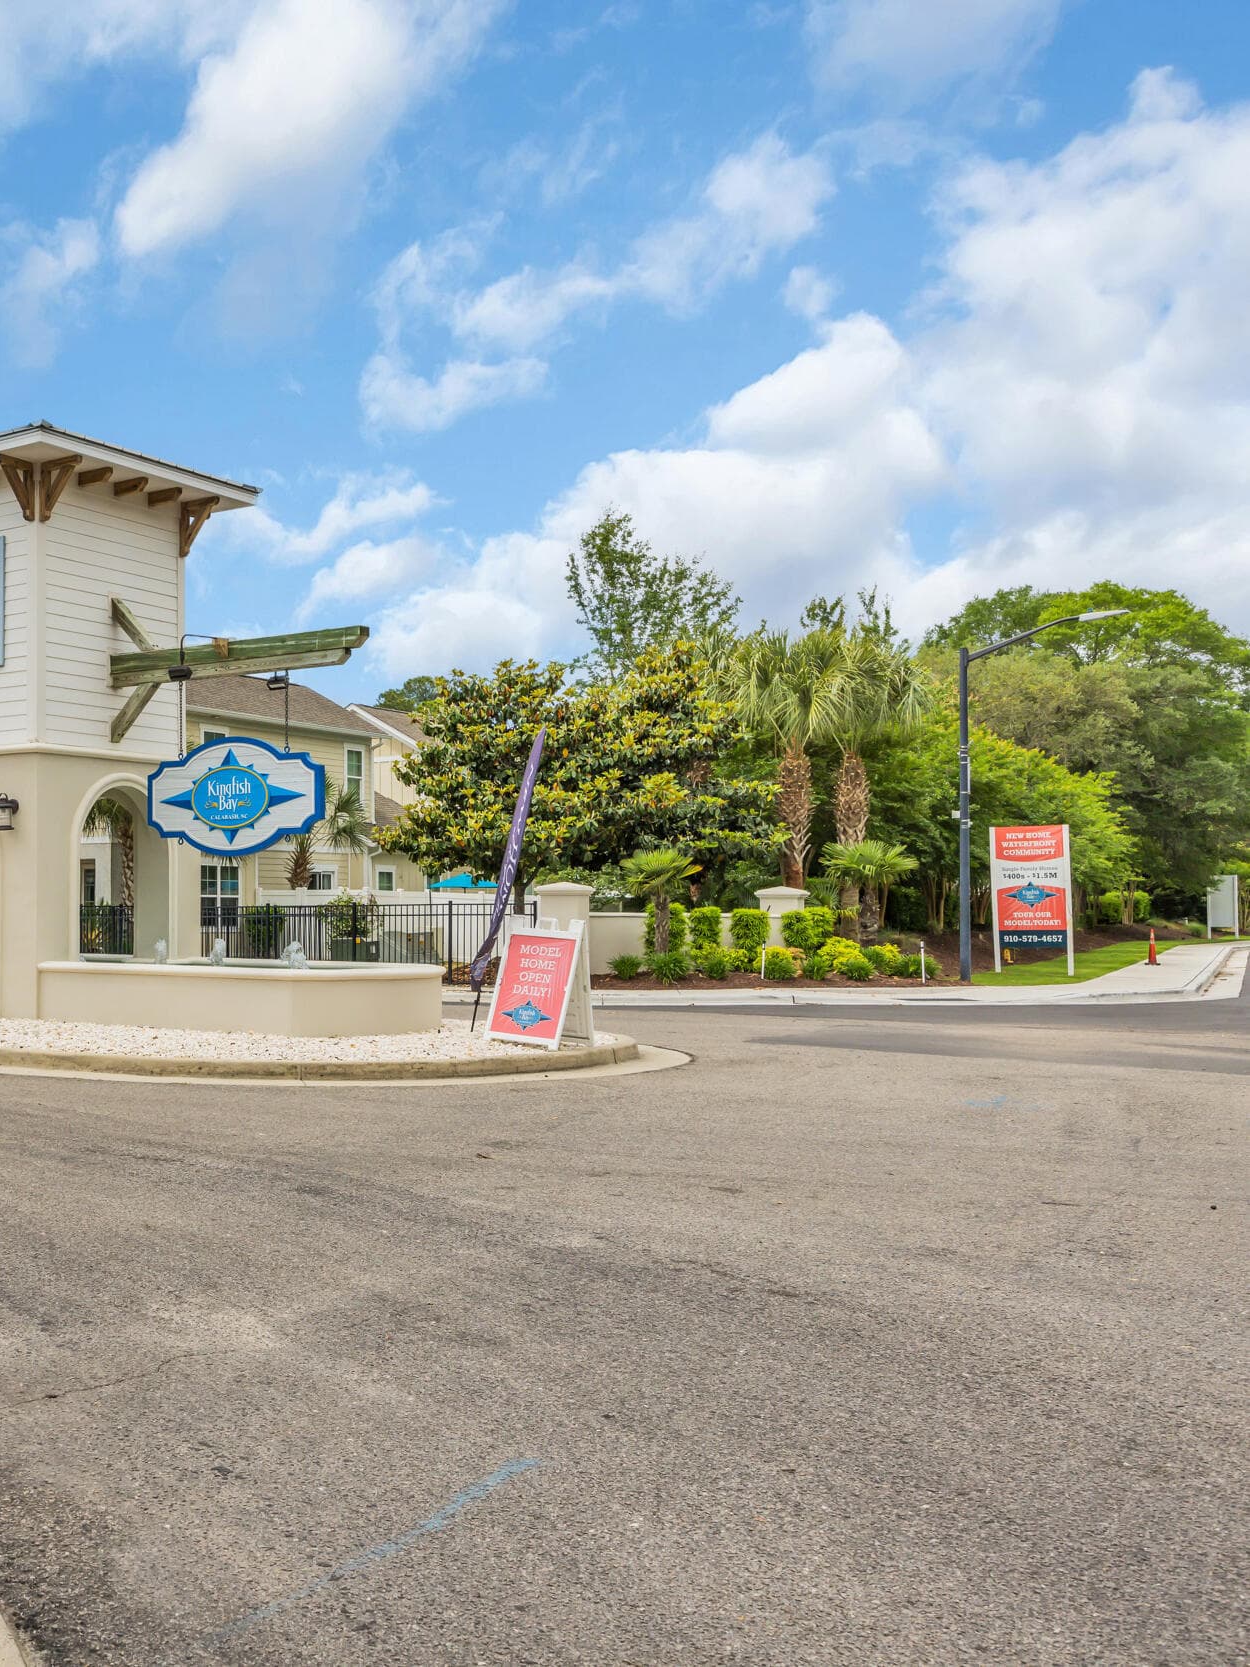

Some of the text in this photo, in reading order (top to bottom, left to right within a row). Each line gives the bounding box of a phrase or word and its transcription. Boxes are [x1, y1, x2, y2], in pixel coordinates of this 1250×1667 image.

[207, 776, 251, 798] Kingfish
[219, 796, 238, 812] Bay
[1006, 831, 1052, 840] NEW HOME
[1001, 840, 1057, 848] WATERFRONT
[1003, 848, 1055, 856] COMMUNITY
[1003, 935, 1063, 943] 910-579-4657
[520, 944, 561, 957] MODEL
[520, 958, 556, 970] HOME
[519, 971, 552, 983] OPEN
[513, 984, 552, 998] DAILY!
